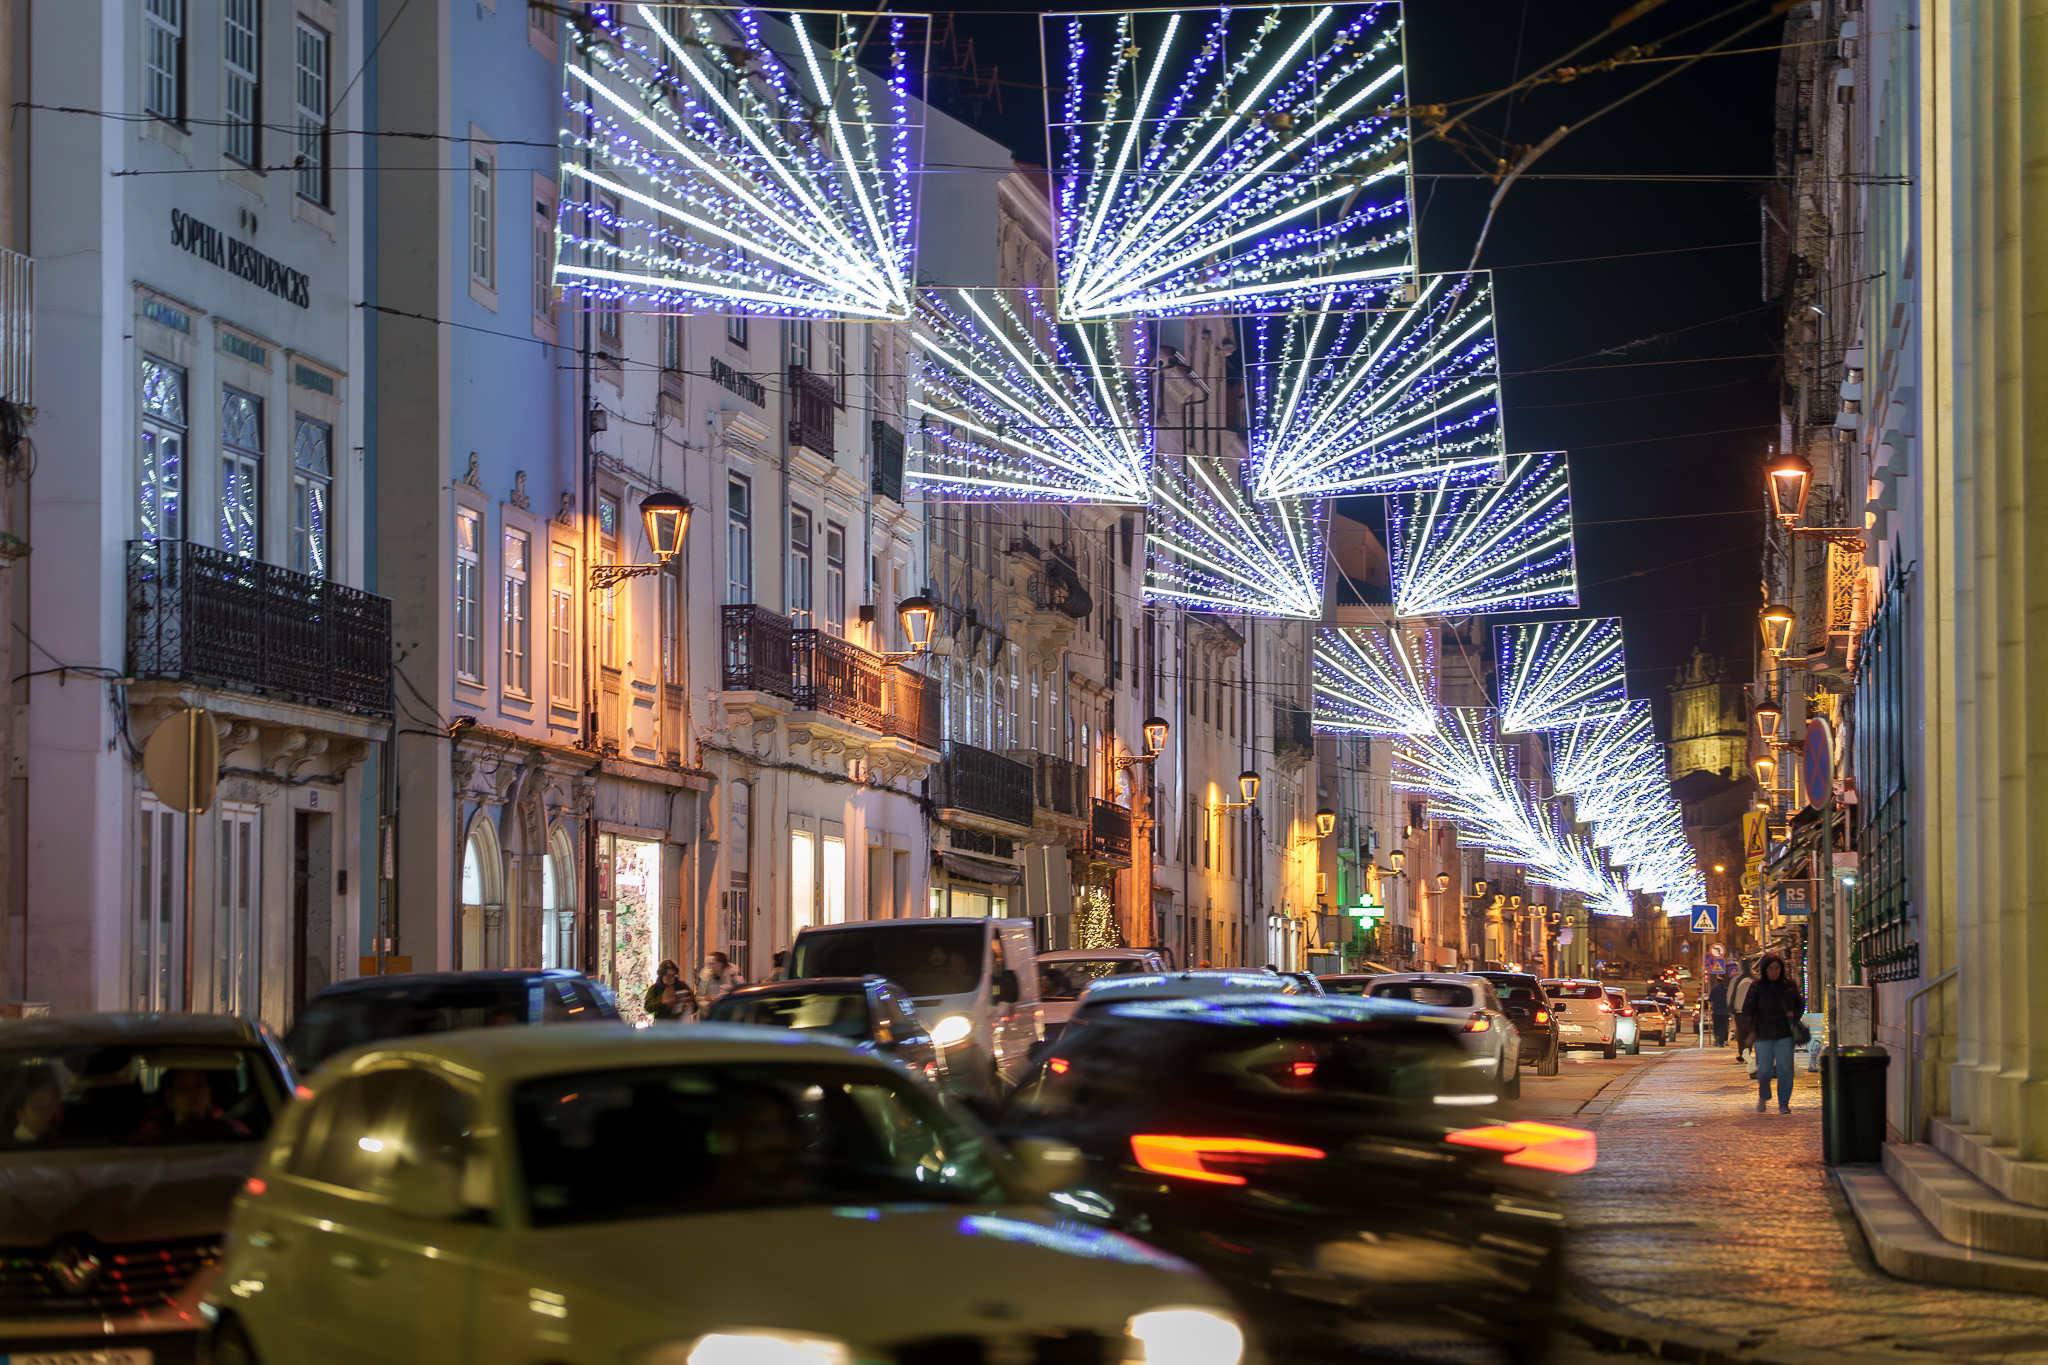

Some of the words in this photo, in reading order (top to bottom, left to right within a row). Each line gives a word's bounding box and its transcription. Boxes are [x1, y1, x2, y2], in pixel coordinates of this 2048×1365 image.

[171, 208, 226, 269] SOPHIA
[227, 236, 309, 309] RESIDENCES
[1785, 888, 1806, 900] RS
